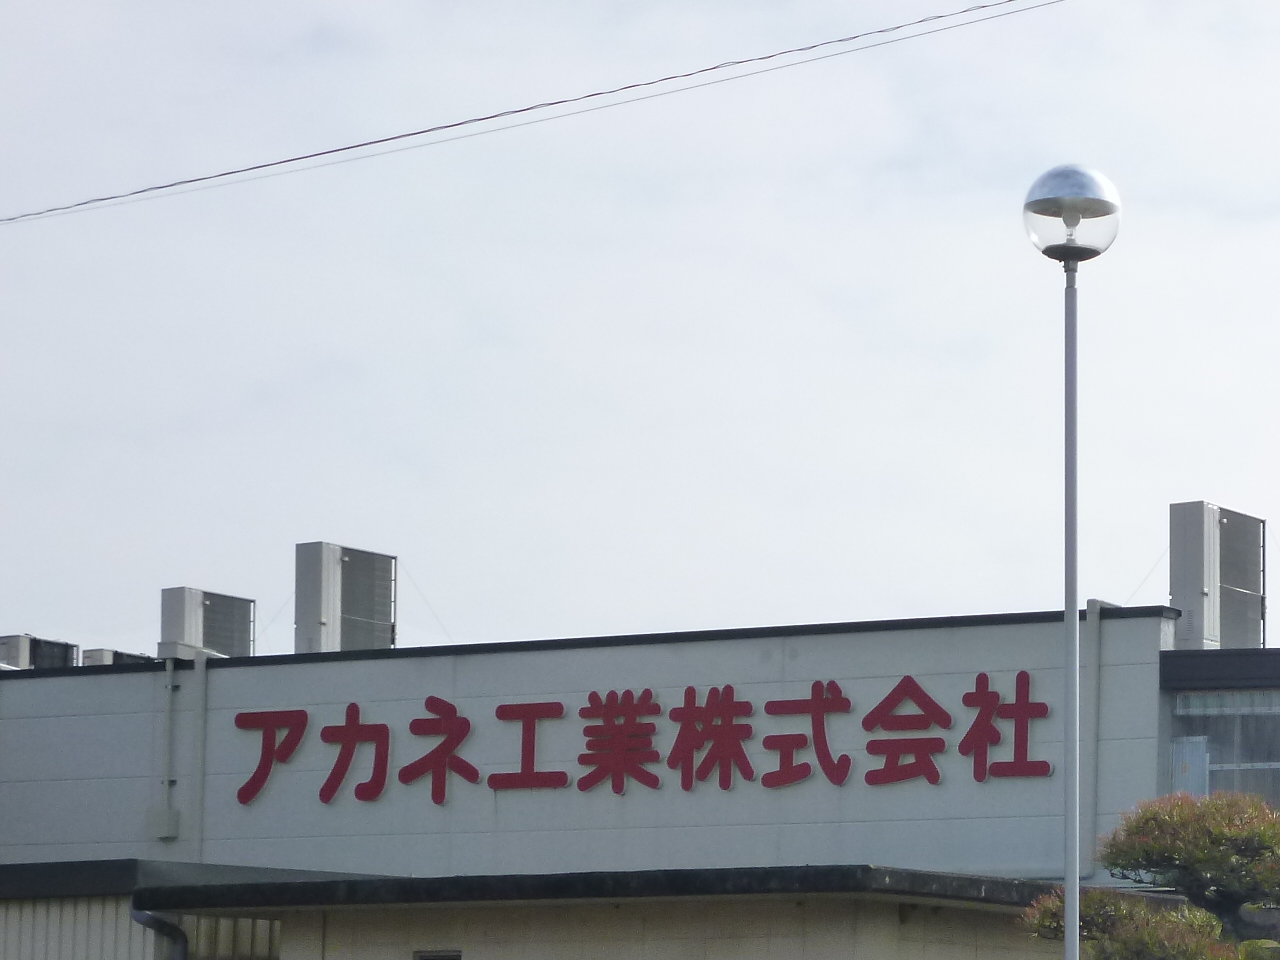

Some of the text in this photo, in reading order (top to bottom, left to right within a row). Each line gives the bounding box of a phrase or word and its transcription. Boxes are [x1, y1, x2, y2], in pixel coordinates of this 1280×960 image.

[234, 671, 1051, 805] アカネ工業株式会社
